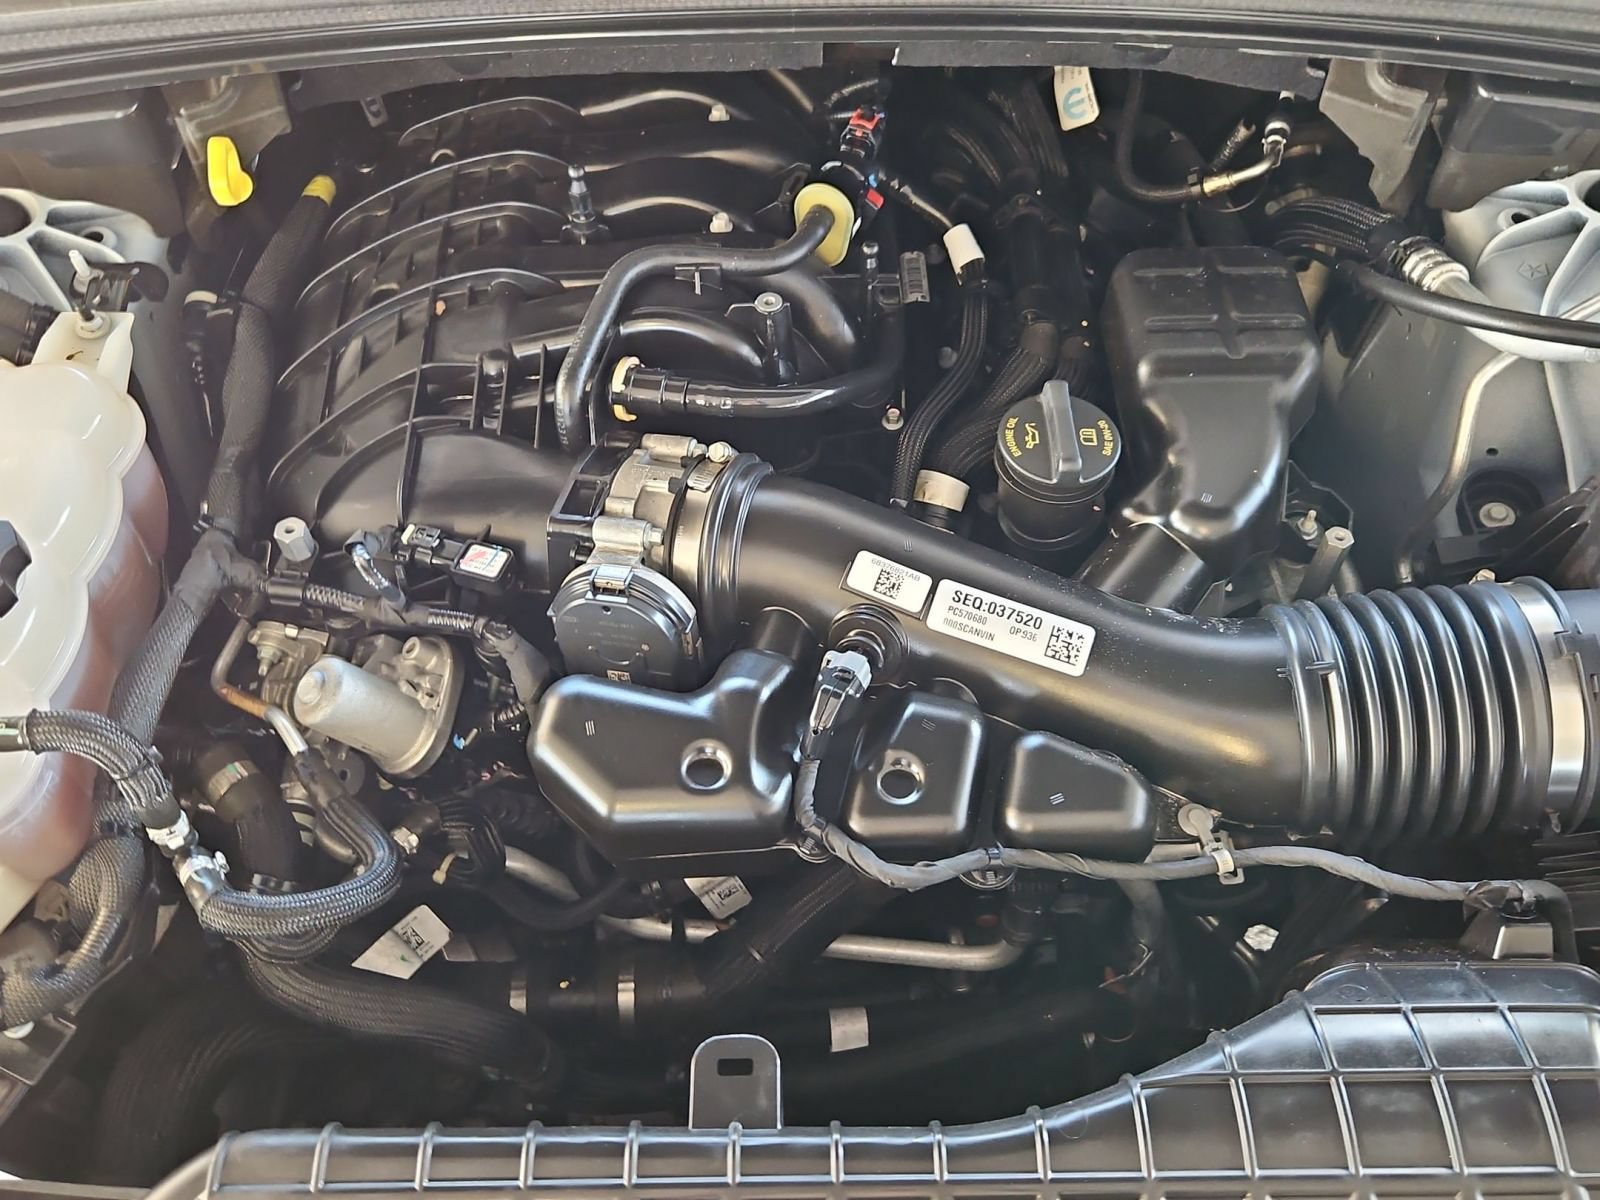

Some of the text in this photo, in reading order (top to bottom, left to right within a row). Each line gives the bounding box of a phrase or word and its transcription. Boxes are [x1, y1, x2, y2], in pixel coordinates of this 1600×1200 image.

[1005, 417, 1022, 457] ENGINE OIL
[1102, 440, 1113, 456] SAE
[947, 605, 988, 626] PC570680
[951, 590, 1043, 630] SEQ:037520
